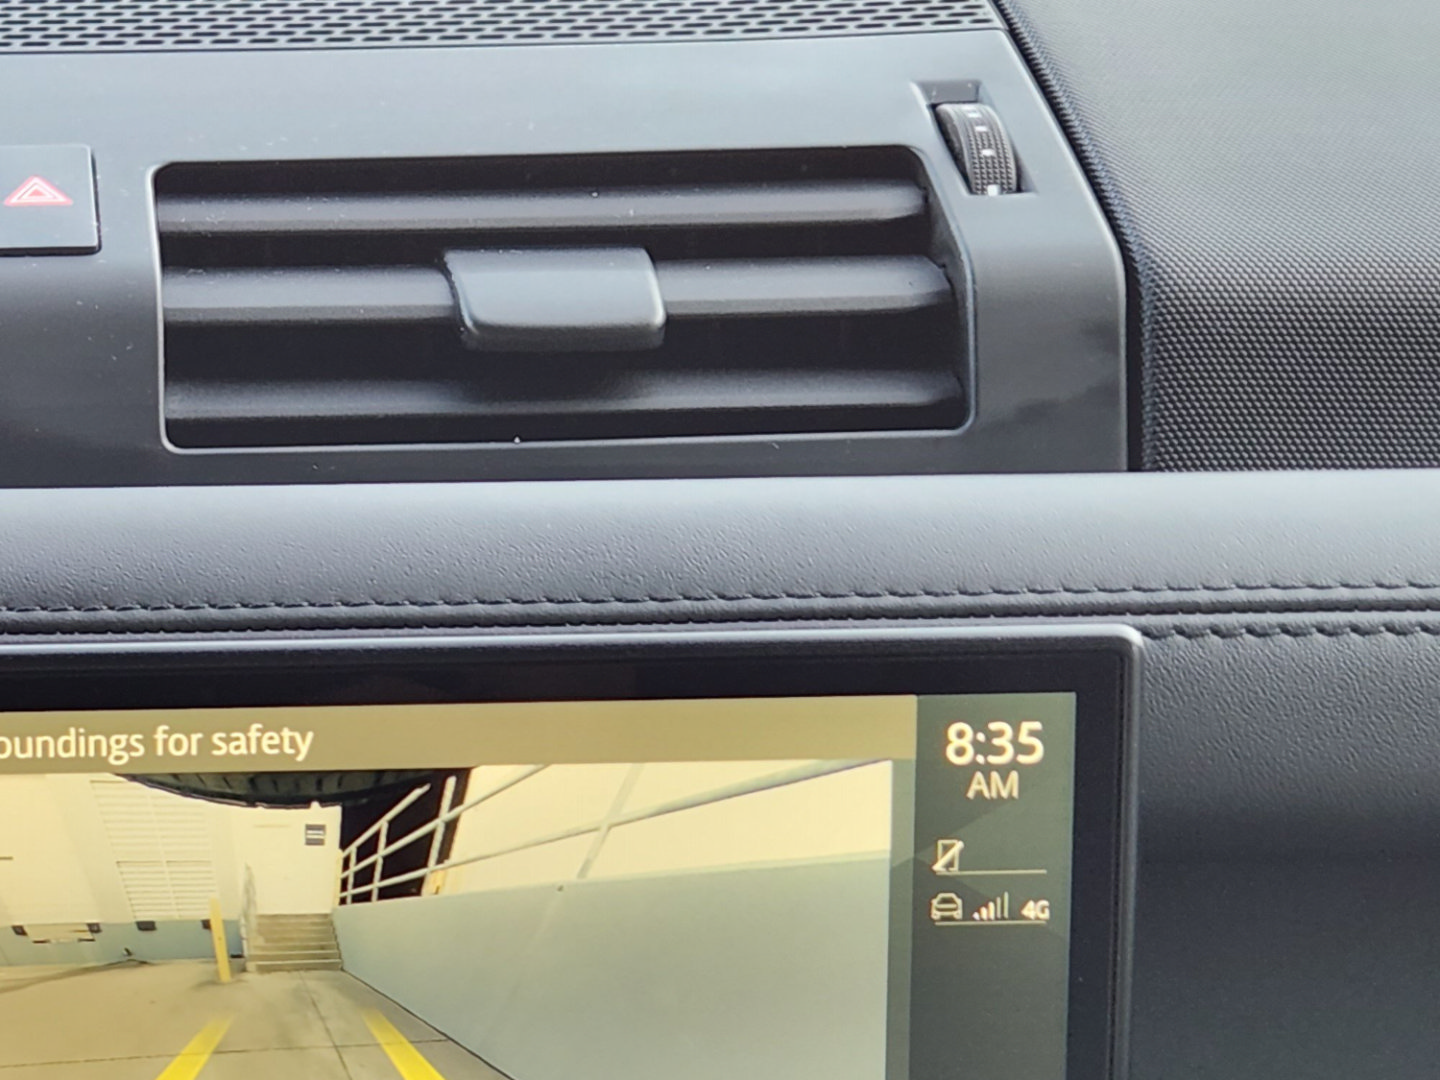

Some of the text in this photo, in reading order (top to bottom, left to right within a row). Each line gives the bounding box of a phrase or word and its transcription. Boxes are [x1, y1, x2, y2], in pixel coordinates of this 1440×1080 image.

[153, 724, 204, 757] for
[211, 722, 315, 763] safety
[944, 720, 1045, 766] 8:35
[965, 769, 1020, 800] AM
[1020, 899, 1051, 921] 4G
